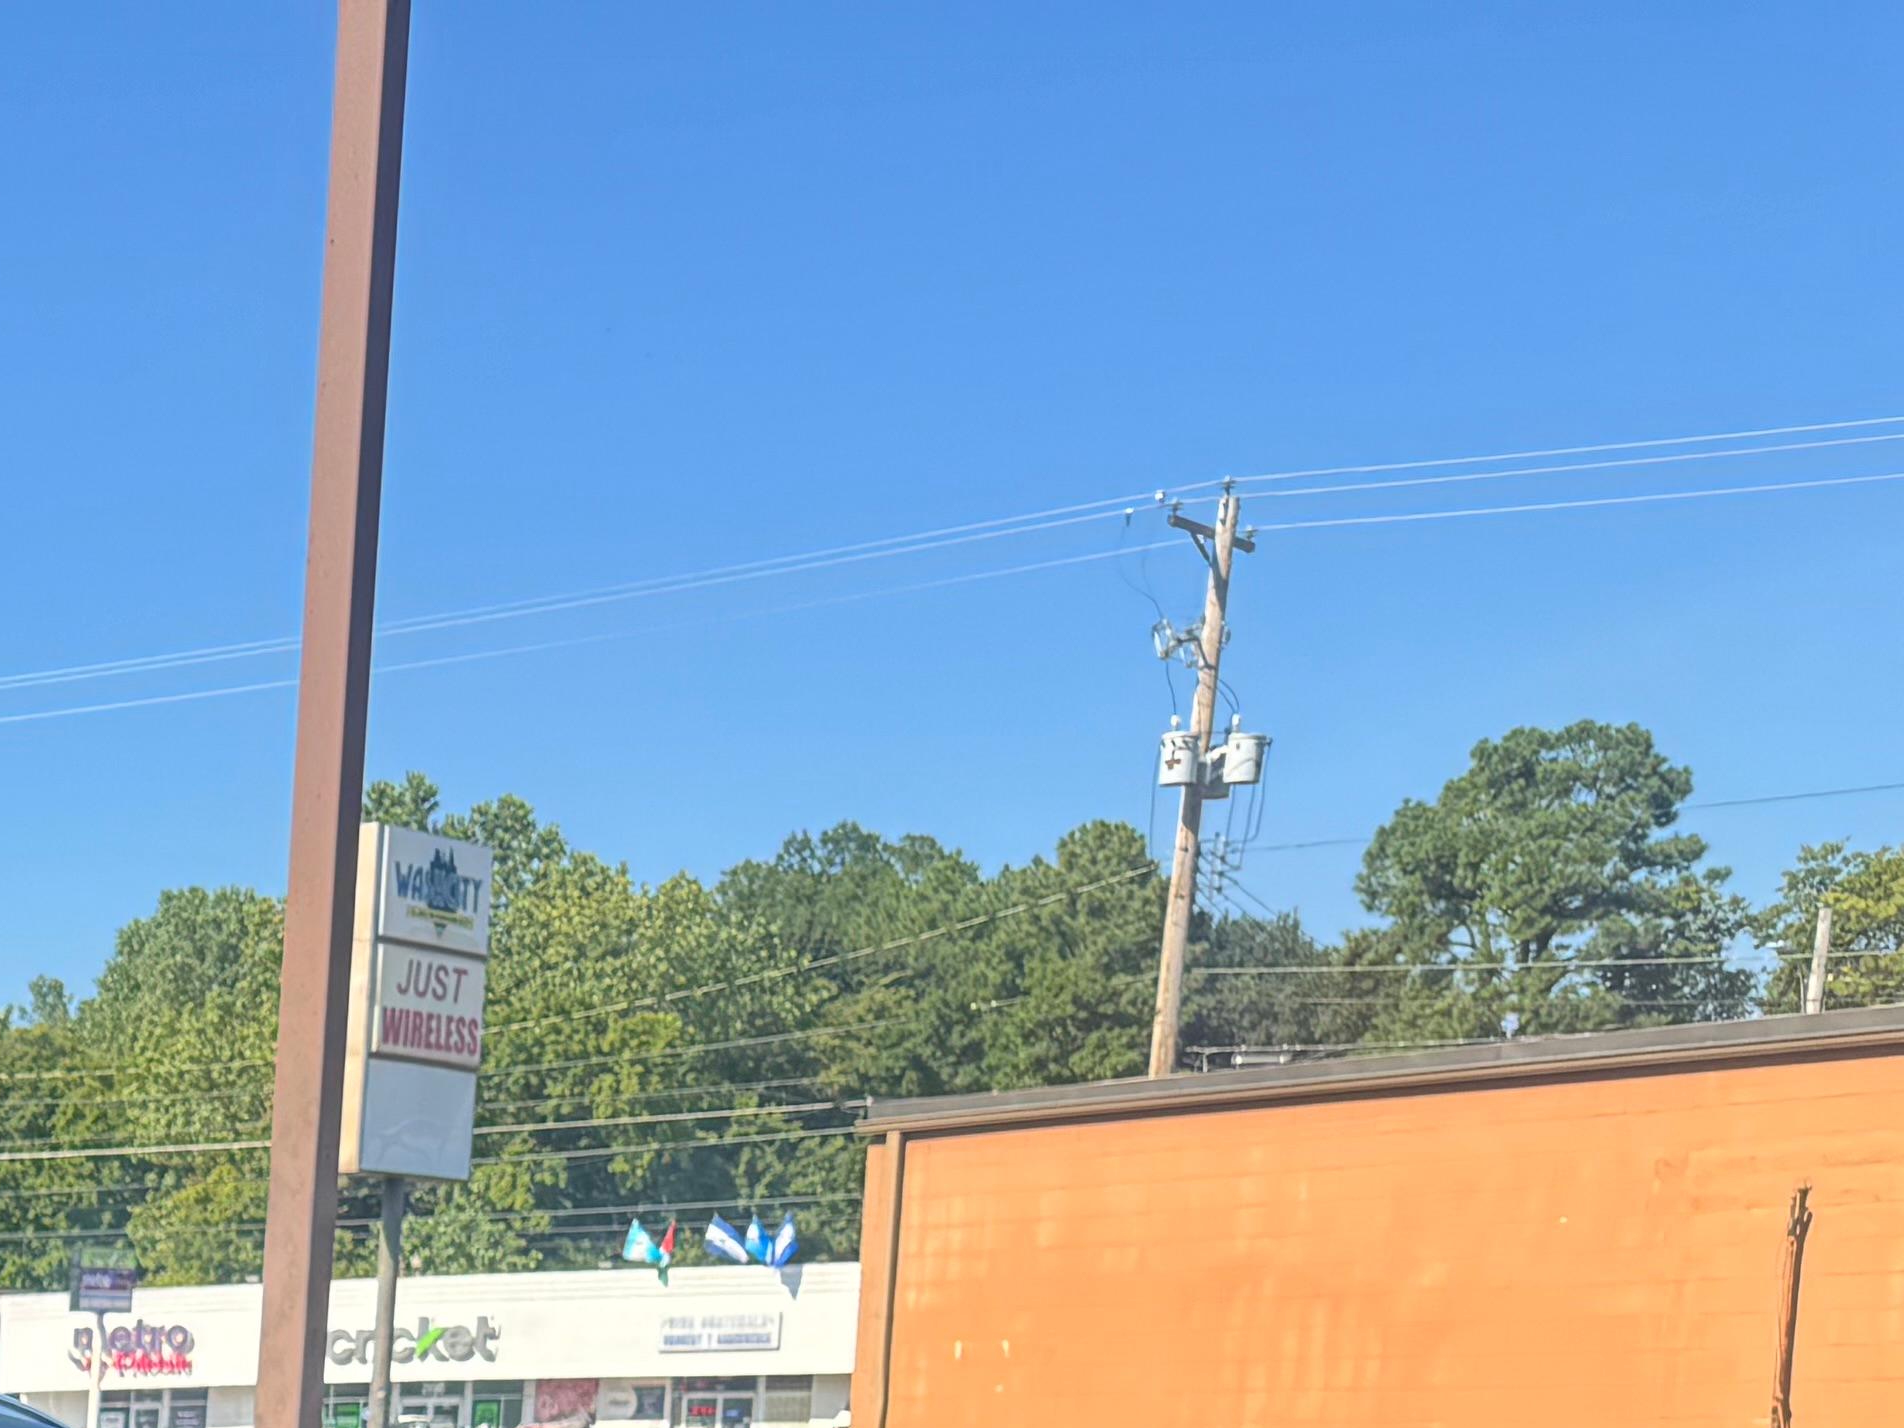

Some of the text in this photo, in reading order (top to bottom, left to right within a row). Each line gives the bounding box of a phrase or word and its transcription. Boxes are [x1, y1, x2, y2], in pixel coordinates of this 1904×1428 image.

[396, 958, 469, 1004] JUST
[382, 1005, 479, 1057] WIRELESS
[326, 1316, 501, 1366] crcket
